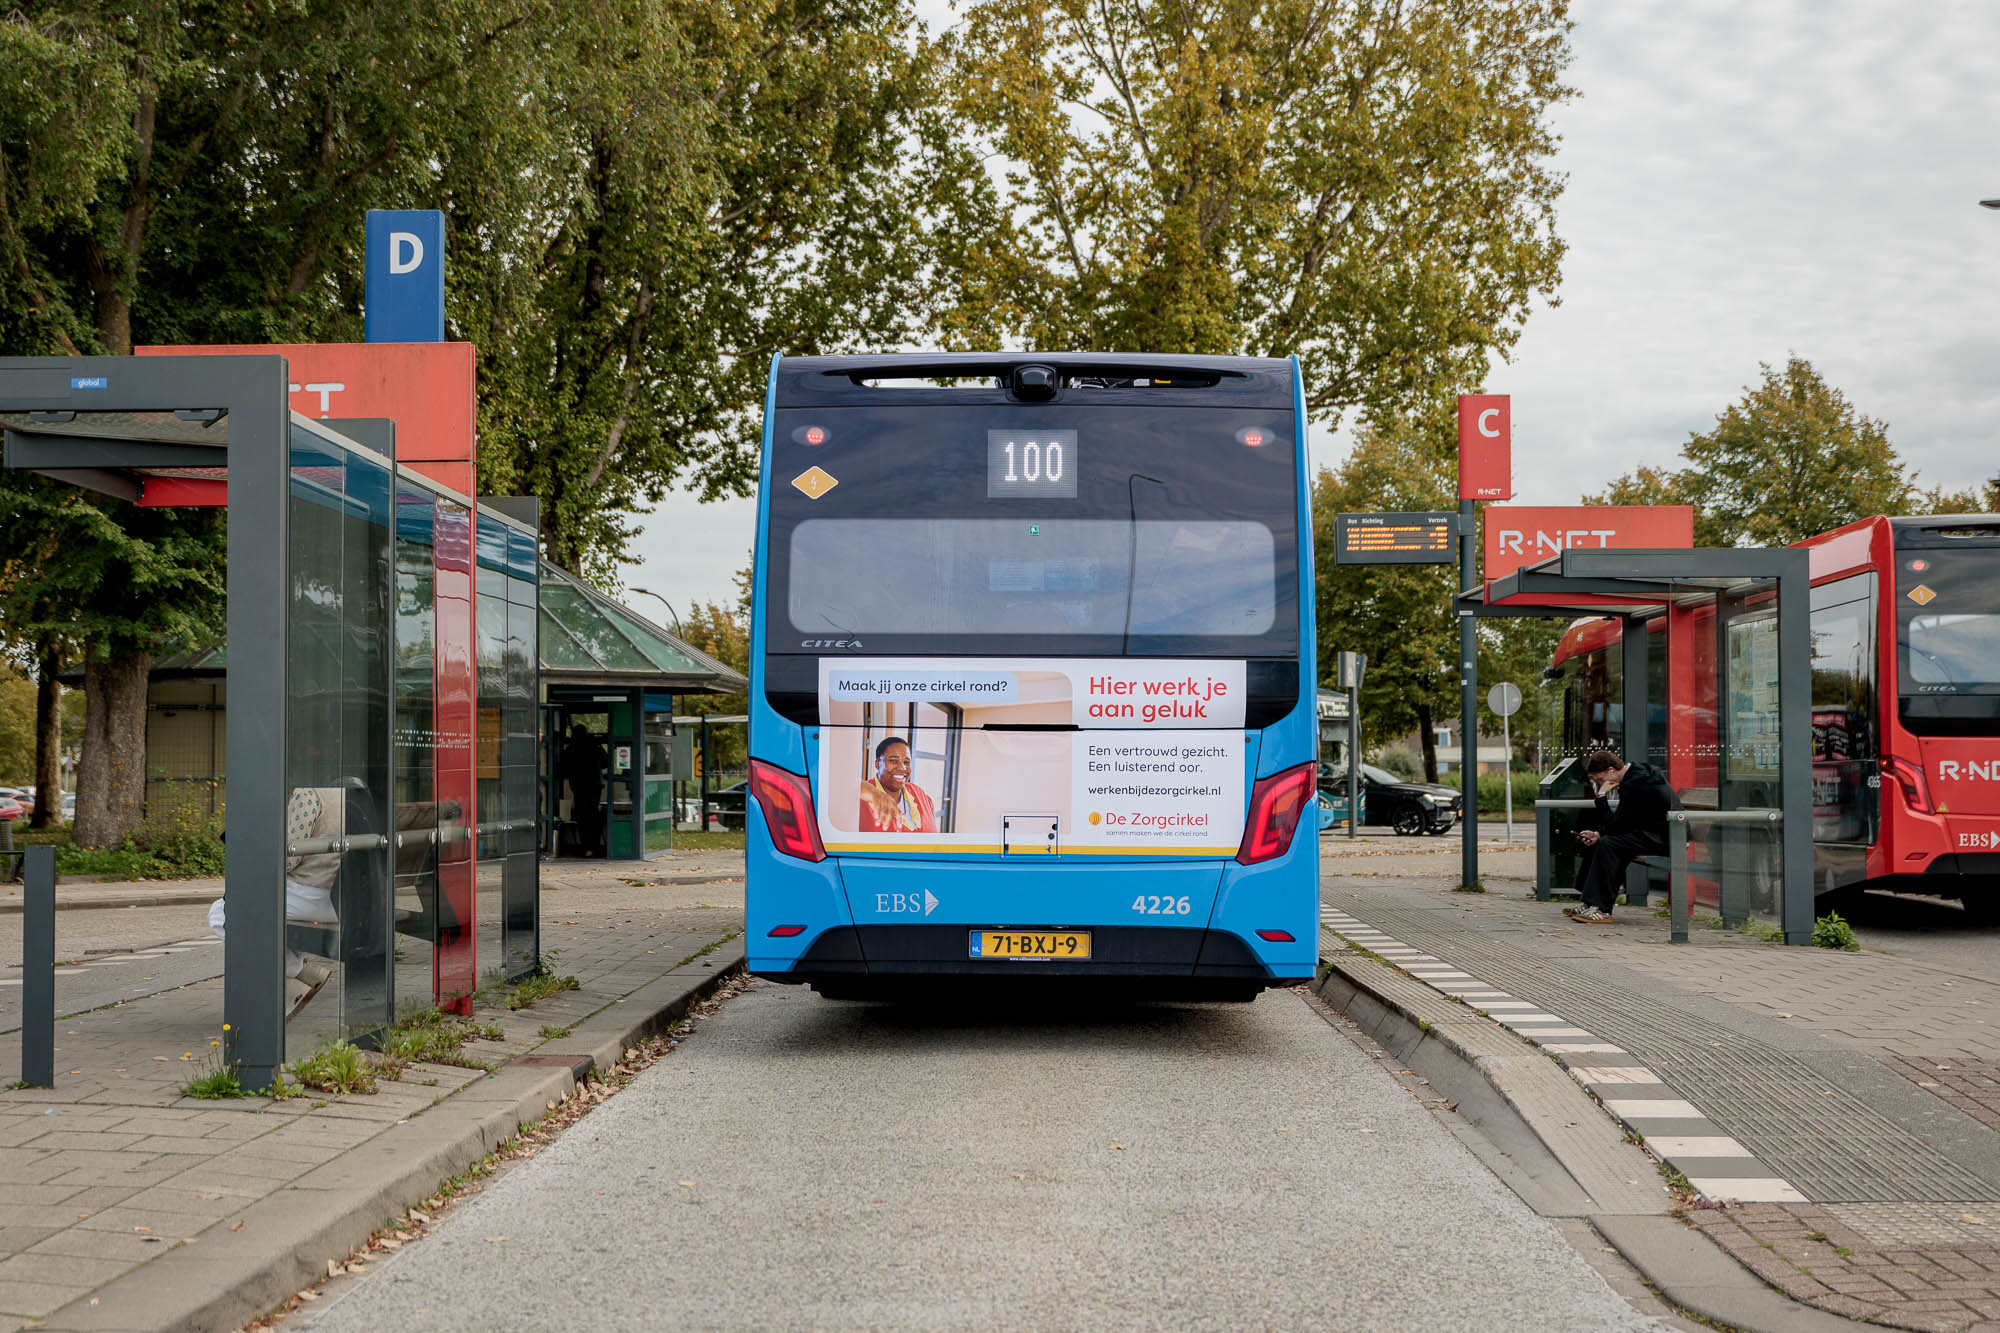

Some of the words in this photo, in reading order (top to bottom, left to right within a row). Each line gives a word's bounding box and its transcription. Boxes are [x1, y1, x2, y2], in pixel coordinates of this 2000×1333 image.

[389, 231, 424, 275] D
[78, 378, 101, 388] global
[1477, 408, 1500, 438] C
[1003, 441, 1063, 482] 100
[1427, 516, 1448, 524] Vertrek
[801, 639, 864, 649] CITEA
[838, 680, 876, 692] Maak
[877, 680, 892, 694] jij
[894, 682, 927, 692] onze
[930, 680, 966, 692] cirkel
[969, 680, 1008, 692] rond?
[1089, 676, 1138, 695] Hier
[1142, 676, 1201, 696] werk
[1202, 677, 1228, 701] je
[1088, 703, 1135, 718] aan
[1141, 699, 1208, 723] geluk
[1088, 745, 1111, 756] Een
[1114, 745, 1178, 757] vertrouwd
[1181, 746, 1228, 759] gezicht.
[1088, 761, 1111, 772] Een
[1114, 761, 1176, 773] luisterend
[1179, 764, 1203, 773] oor.
[1088, 785, 1221, 798] werkenbijdezorgcirkel.nl
[1105, 812, 1127, 826] De
[1130, 812, 1208, 829] Zorgcirkel
[1129, 829, 1152, 837] maken
[1164, 829, 1174, 837] de
[1958, 833, 1989, 847] EBS
[875, 892, 921, 914] EBS
[1131, 895, 1191, 915] 4226
[971, 945, 981, 953] NL
[992, 935, 1078, 954] 71-BXJ-9
